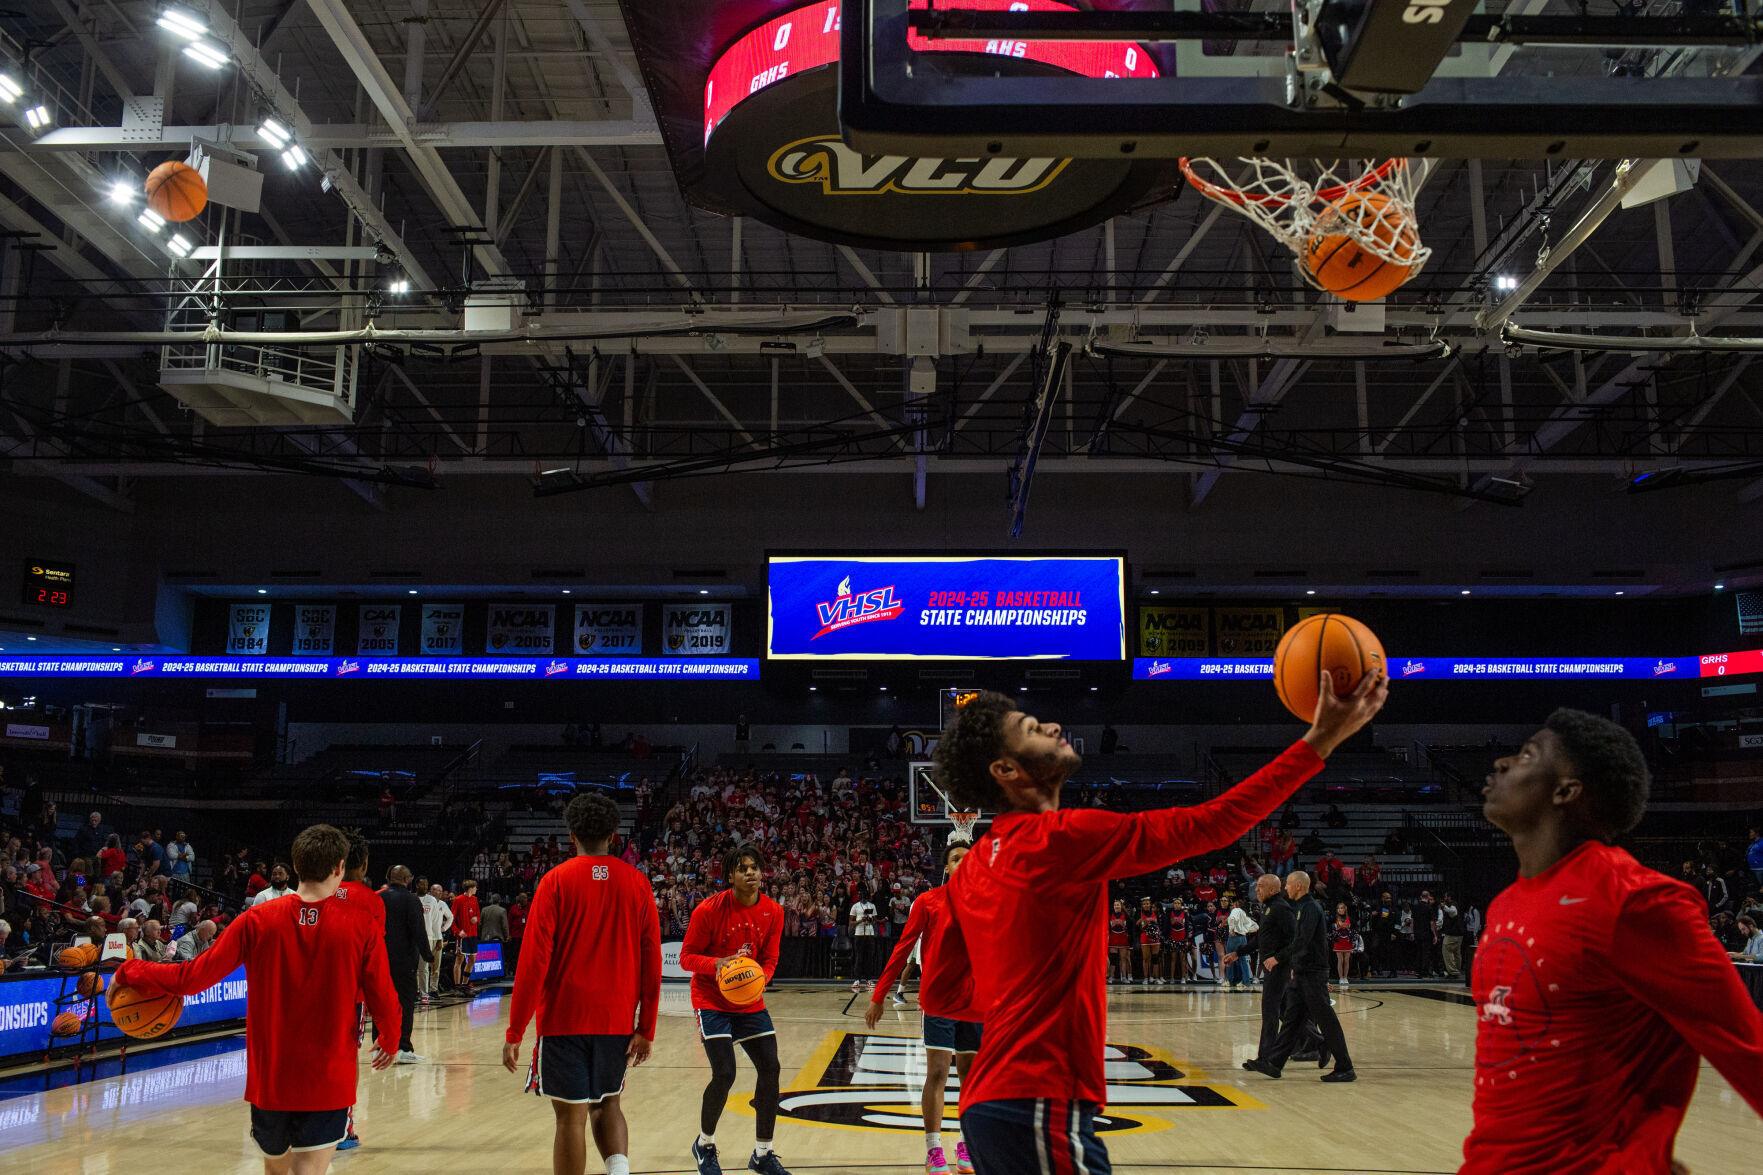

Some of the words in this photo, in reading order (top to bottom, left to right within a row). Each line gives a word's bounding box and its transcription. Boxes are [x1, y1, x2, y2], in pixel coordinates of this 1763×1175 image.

[774, 22, 792, 51] 0
[985, 39, 1027, 58] AHS
[750, 61, 789, 94] GRHS
[928, 591, 989, 607] 2024-25
[996, 591, 1082, 607] BASKETBALL
[816, 585, 903, 627] VHSL
[363, 609, 396, 621] CAA
[492, 610, 549, 628] NCAA
[579, 611, 636, 628] NCAA
[668, 611, 725, 628] NCAA
[919, 609, 963, 626] STATE
[965, 609, 1087, 626] CHAMPIONSHIPS
[1145, 613, 1202, 631] NCAA
[1221, 615, 1277, 631] NCAA
[232, 637, 264, 650] 1984
[298, 638, 331, 651] 1985
[361, 638, 395, 650] 2005
[427, 637, 457, 649] 2017
[515, 636, 551, 648] 2005
[601, 635, 635, 648] 2017
[690, 635, 723, 648] 2019
[1701, 654, 1728, 665] GRHS
[37, 662, 60, 672] STATE
[61, 662, 124, 672] CHAMPIONSHIPS
[162, 662, 194, 672] 2024-25
[195, 662, 240, 672] BASKETBALL
[241, 662, 264, 673] STATE
[265, 663, 328, 673] CHAMPIONSHIPS
[367, 663, 400, 673] 2024-25
[401, 663, 446, 673] BASKETBALL
[448, 663, 471, 673] STATE
[472, 663, 536, 674] CHAMPIONSHIPS
[576, 664, 610, 674] 2024-25
[610, 664, 657, 674] BASKETBALL
[658, 664, 682, 674] STATE
[683, 664, 748, 674] CHAMPIONSHIPS
[1200, 664, 1234, 674] 2024-25
[1453, 664, 1486, 674] 2024-25
[1487, 663, 1533, 674] BASKETBALL
[1534, 663, 1558, 673] STATE
[1558, 663, 1624, 673] CHAMPIONSHIPS
[1717, 665, 1725, 675] 0
[592, 865, 609, 881] 25
[335, 888, 348, 900] 21
[298, 907, 319, 926] 13
[724, 969, 755, 985] Wilson
